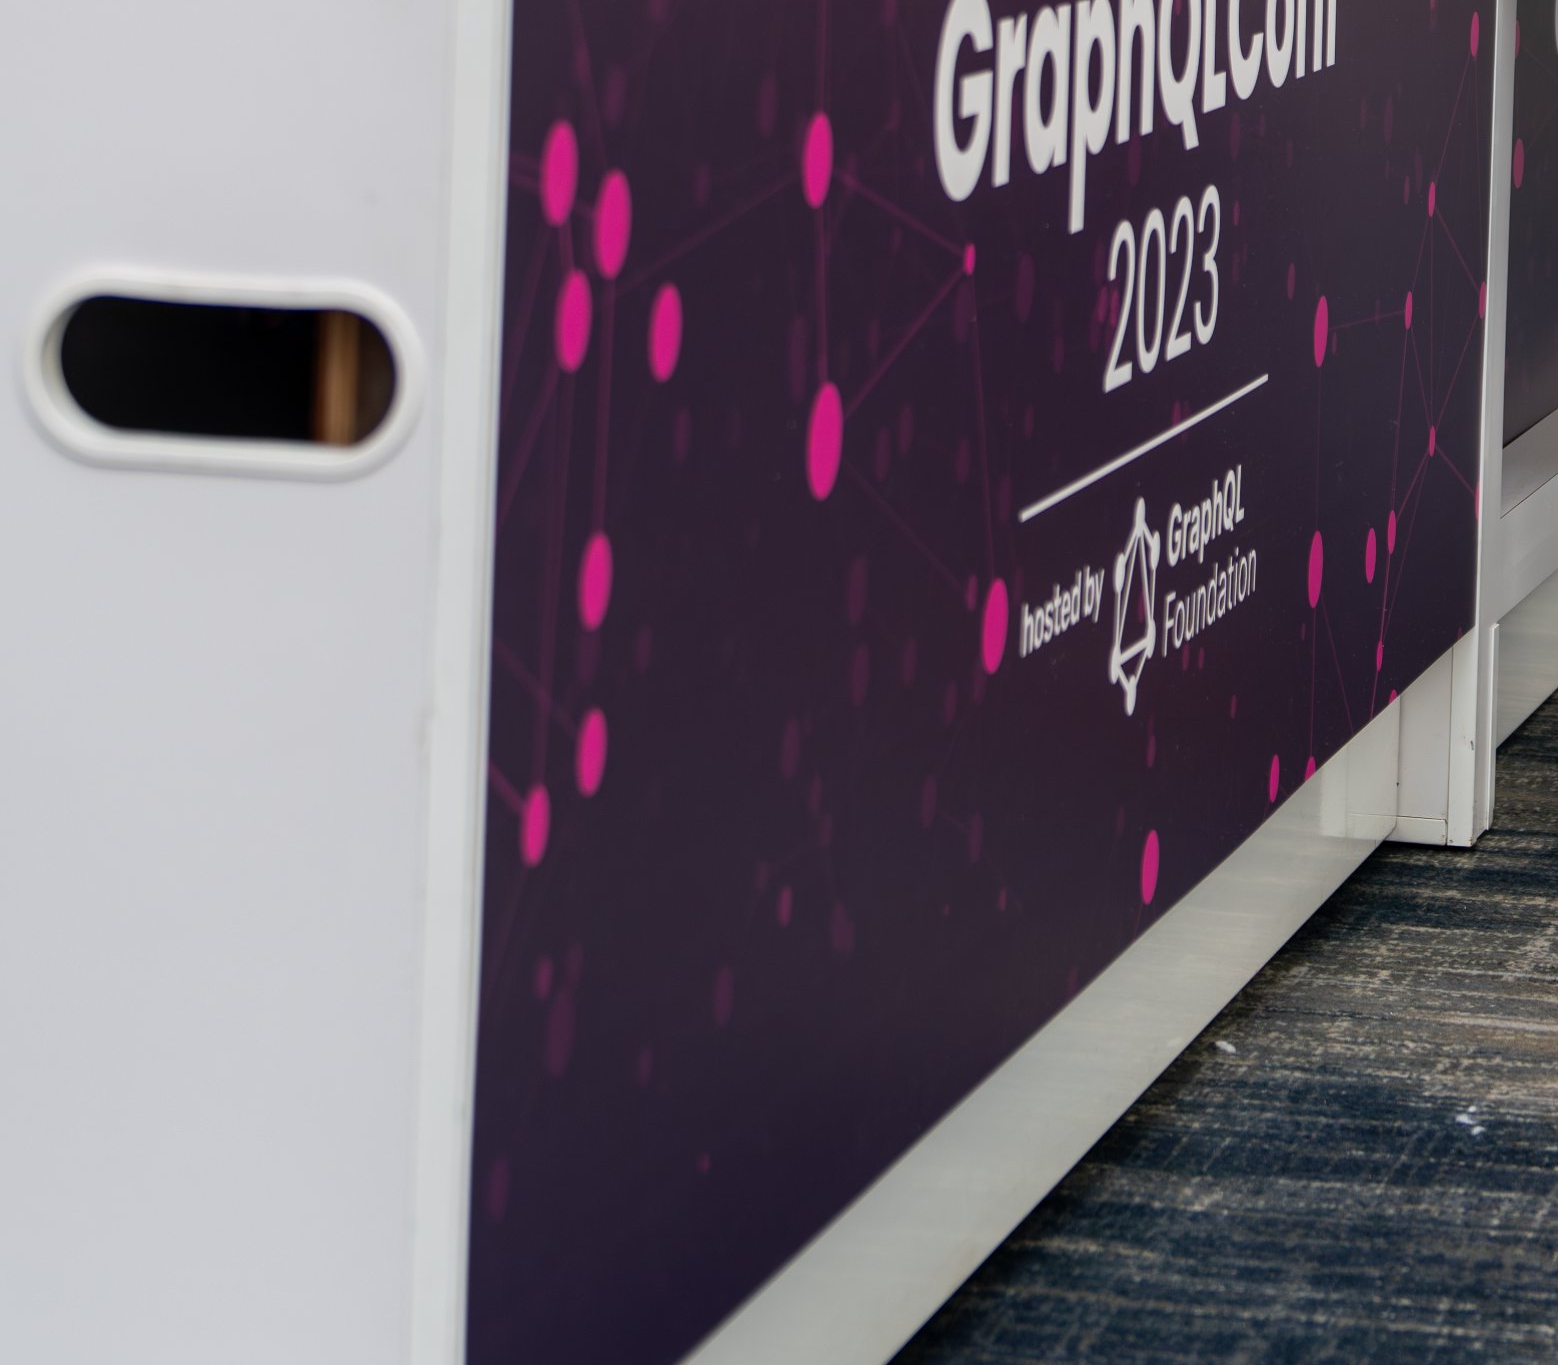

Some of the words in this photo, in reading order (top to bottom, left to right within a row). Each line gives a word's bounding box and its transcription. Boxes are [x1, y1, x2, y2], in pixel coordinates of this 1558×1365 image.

[1102, 184, 1220, 393] 2023
[1167, 464, 1245, 567] GraphQL
[1020, 569, 1082, 658] hosted
[1084, 565, 1105, 624] by
[1162, 547, 1257, 658] Foundation
